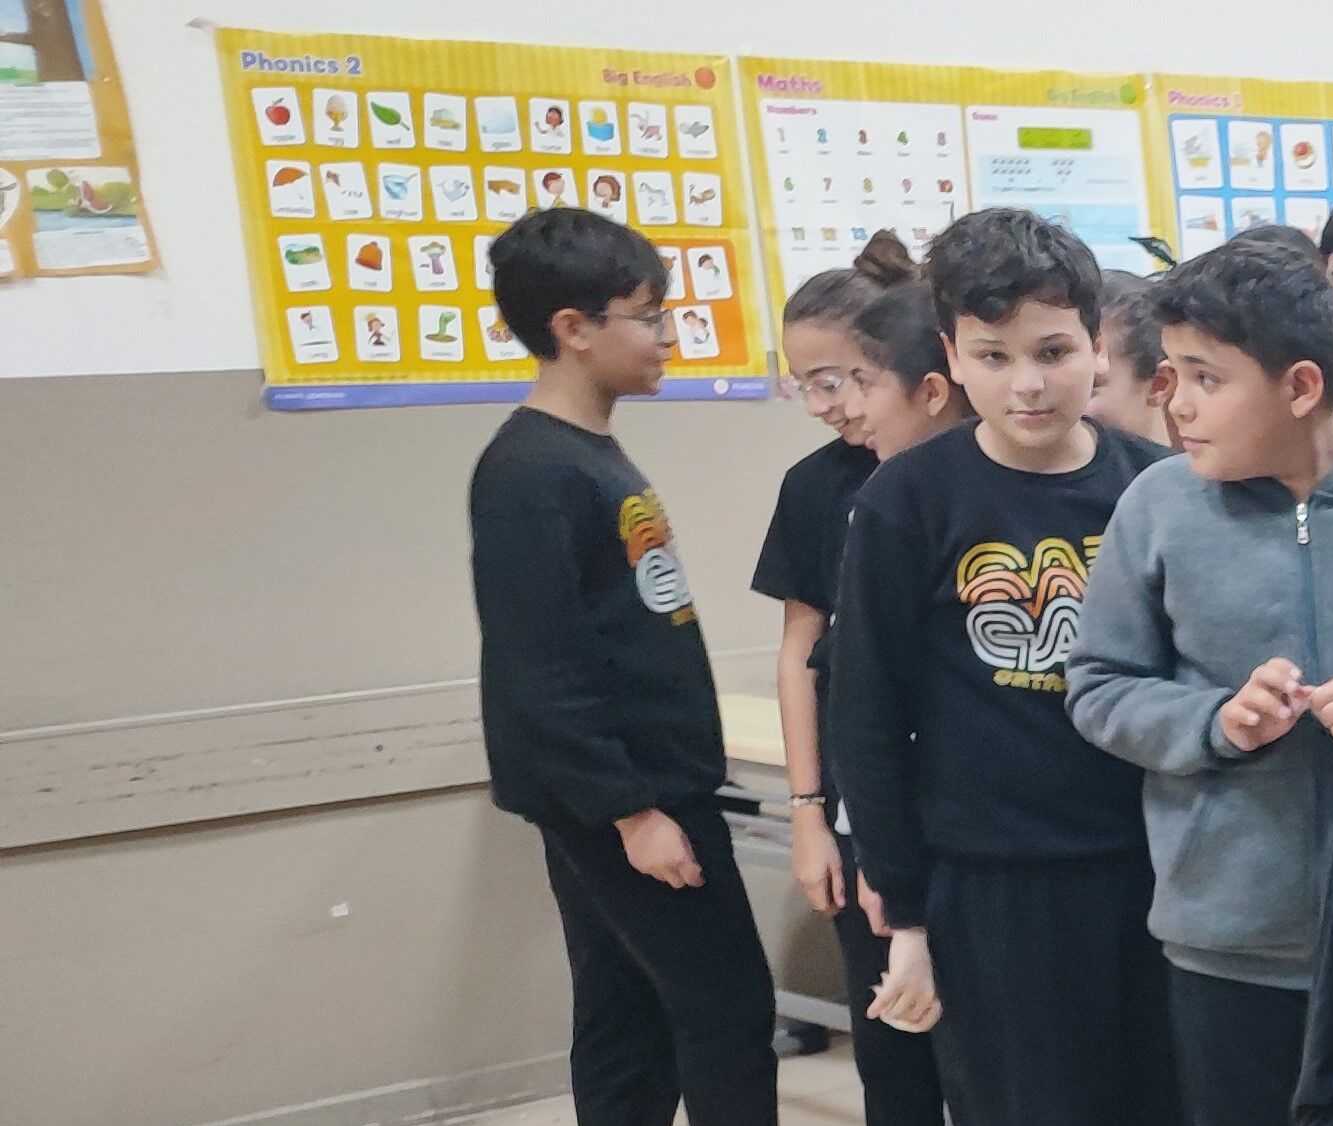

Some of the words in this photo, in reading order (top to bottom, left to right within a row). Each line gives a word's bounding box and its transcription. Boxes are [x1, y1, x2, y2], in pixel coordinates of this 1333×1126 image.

[241, 52, 340, 75] Phonics
[346, 56, 362, 75] 2
[757, 75, 823, 93] Maths
